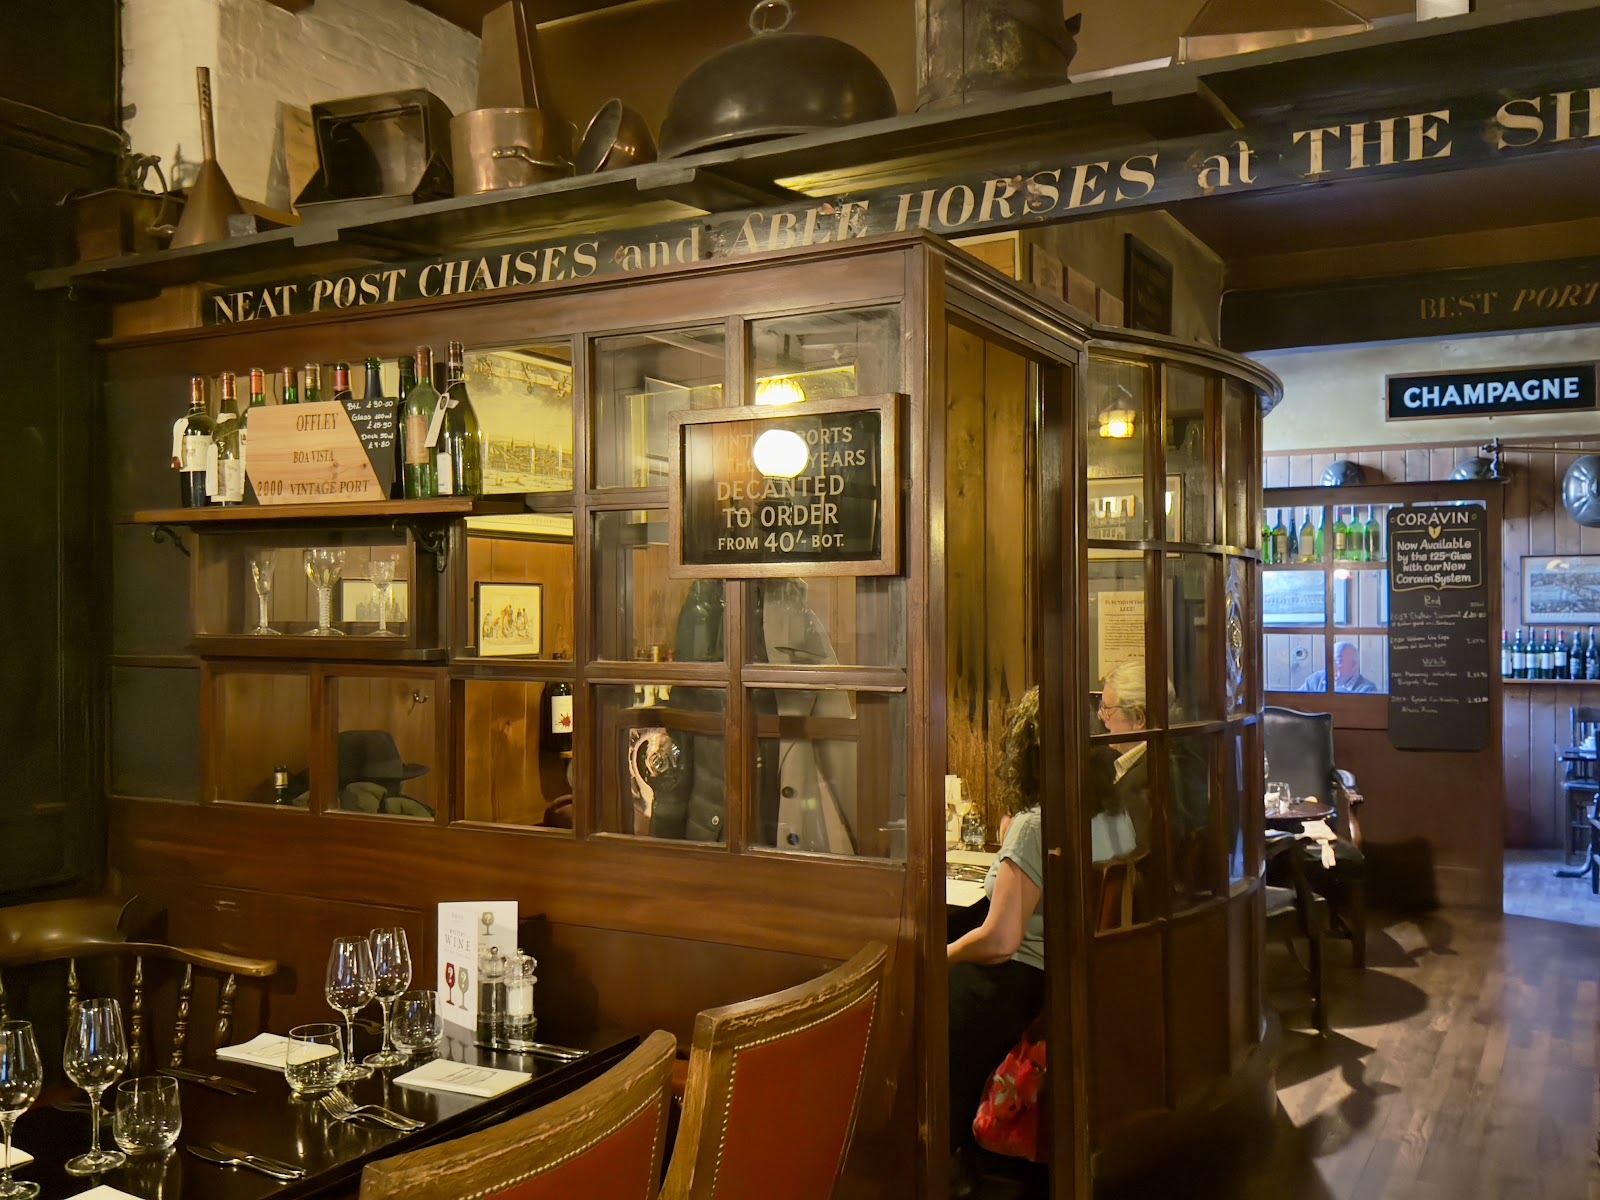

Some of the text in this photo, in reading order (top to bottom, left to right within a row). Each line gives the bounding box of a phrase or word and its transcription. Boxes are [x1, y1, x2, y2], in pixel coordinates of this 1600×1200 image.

[212, 284, 297, 326] NEAT
[307, 269, 407, 313] POST
[418, 241, 599, 298] CHAISES
[621, 226, 700, 272] and
[728, 199, 870, 257] ABLE
[894, 152, 1159, 233] HORSES
[1197, 139, 1259, 192] at
[1292, 109, 1453, 177] THE
[1419, 290, 1499, 321] BEST
[1402, 376, 1580, 409] CHAMPAGNE
[296, 412, 339, 432] OFFLEY
[293, 449, 335, 464] BOA VISTA
[809, 449, 866, 468] YEARS
[257, 480, 370, 497] 2000 VINTAGE PORT
[716, 474, 846, 501] DECANTED
[722, 503, 839, 529] TO ORDER
[1396, 511, 1469, 526] CORAVIN
[717, 536, 759, 551] FROM
[811, 533, 845, 548] BOT.
[1397, 537, 1472, 551] Now Available
[1397, 551, 1409, 564] by
[1411, 551, 1427, 561] the
[1450, 551, 1472, 561] Glass
[1403, 561, 1466, 572] with our New
[1396, 572, 1471, 586] Coravin System
[444, 933, 471, 952] WINE
